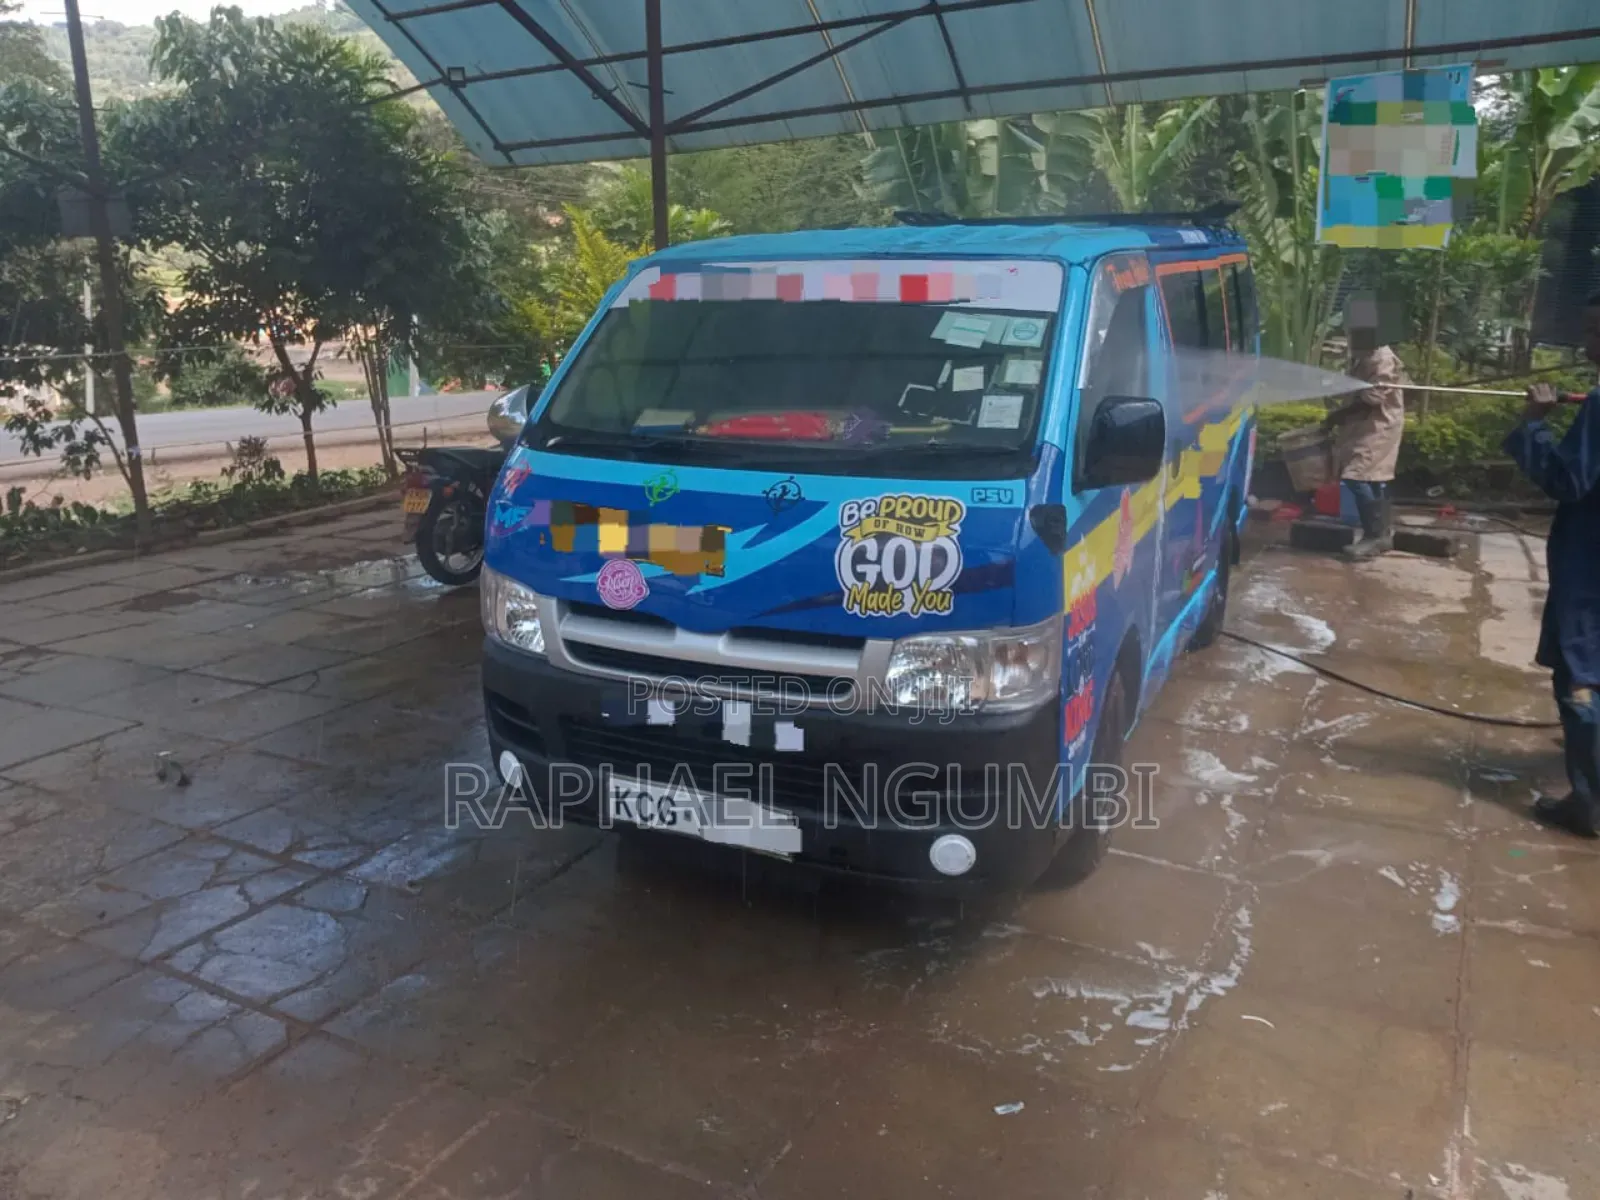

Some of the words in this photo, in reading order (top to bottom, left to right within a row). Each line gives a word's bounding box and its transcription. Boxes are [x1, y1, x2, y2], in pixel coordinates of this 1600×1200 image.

[879, 495, 963, 524] PROUD
[873, 518, 890, 530] OF
[895, 522, 926, 538] HOW
[840, 537, 959, 591] GOD
[847, 580, 902, 614] Made
[911, 578, 952, 614] You
[614, 785, 677, 826] KCG
